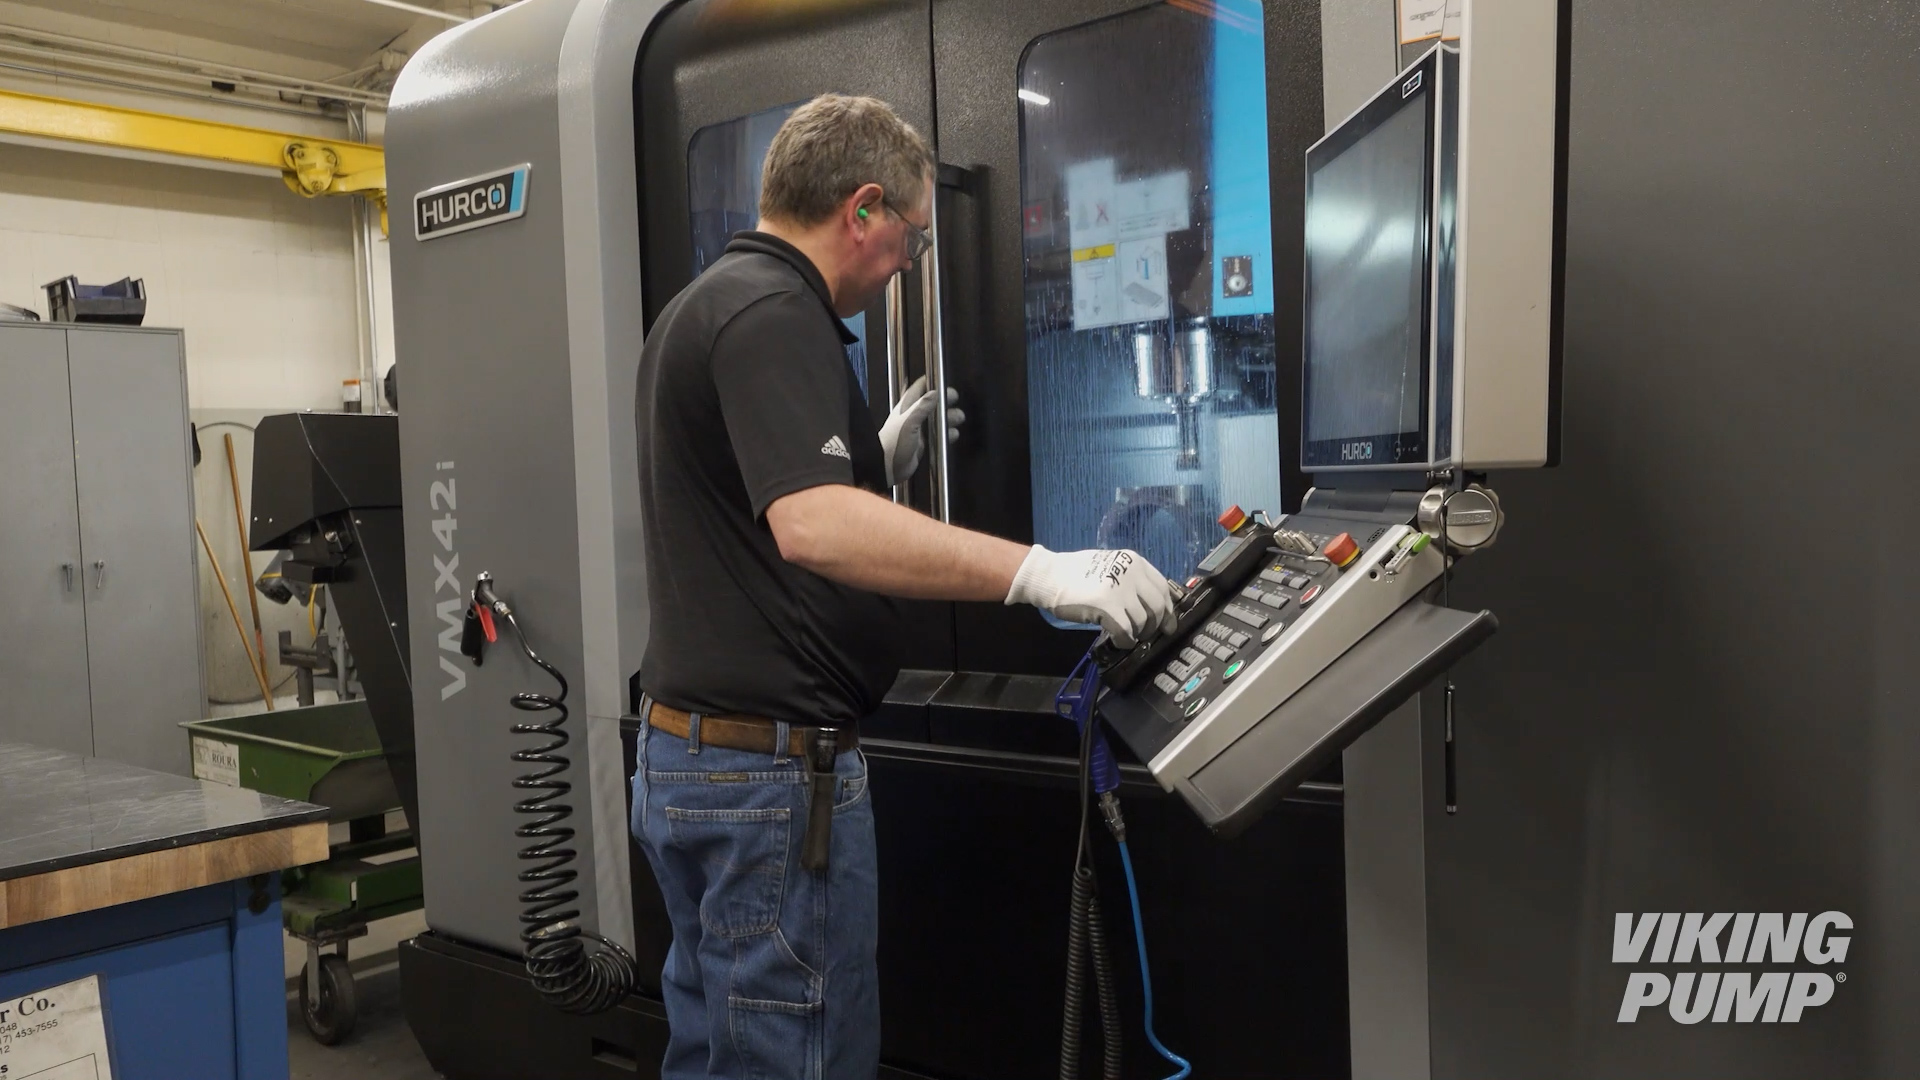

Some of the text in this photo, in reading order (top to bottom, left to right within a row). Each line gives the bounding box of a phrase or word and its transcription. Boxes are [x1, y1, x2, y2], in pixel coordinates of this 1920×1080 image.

[422, 183, 506, 227] HURCO
[1341, 441, 1373, 461] HURCO
[429, 461, 467, 701] VMX42i
[18, 997, 56, 1016] Co.
[15, 1019, 58, 1039] 453-7555
